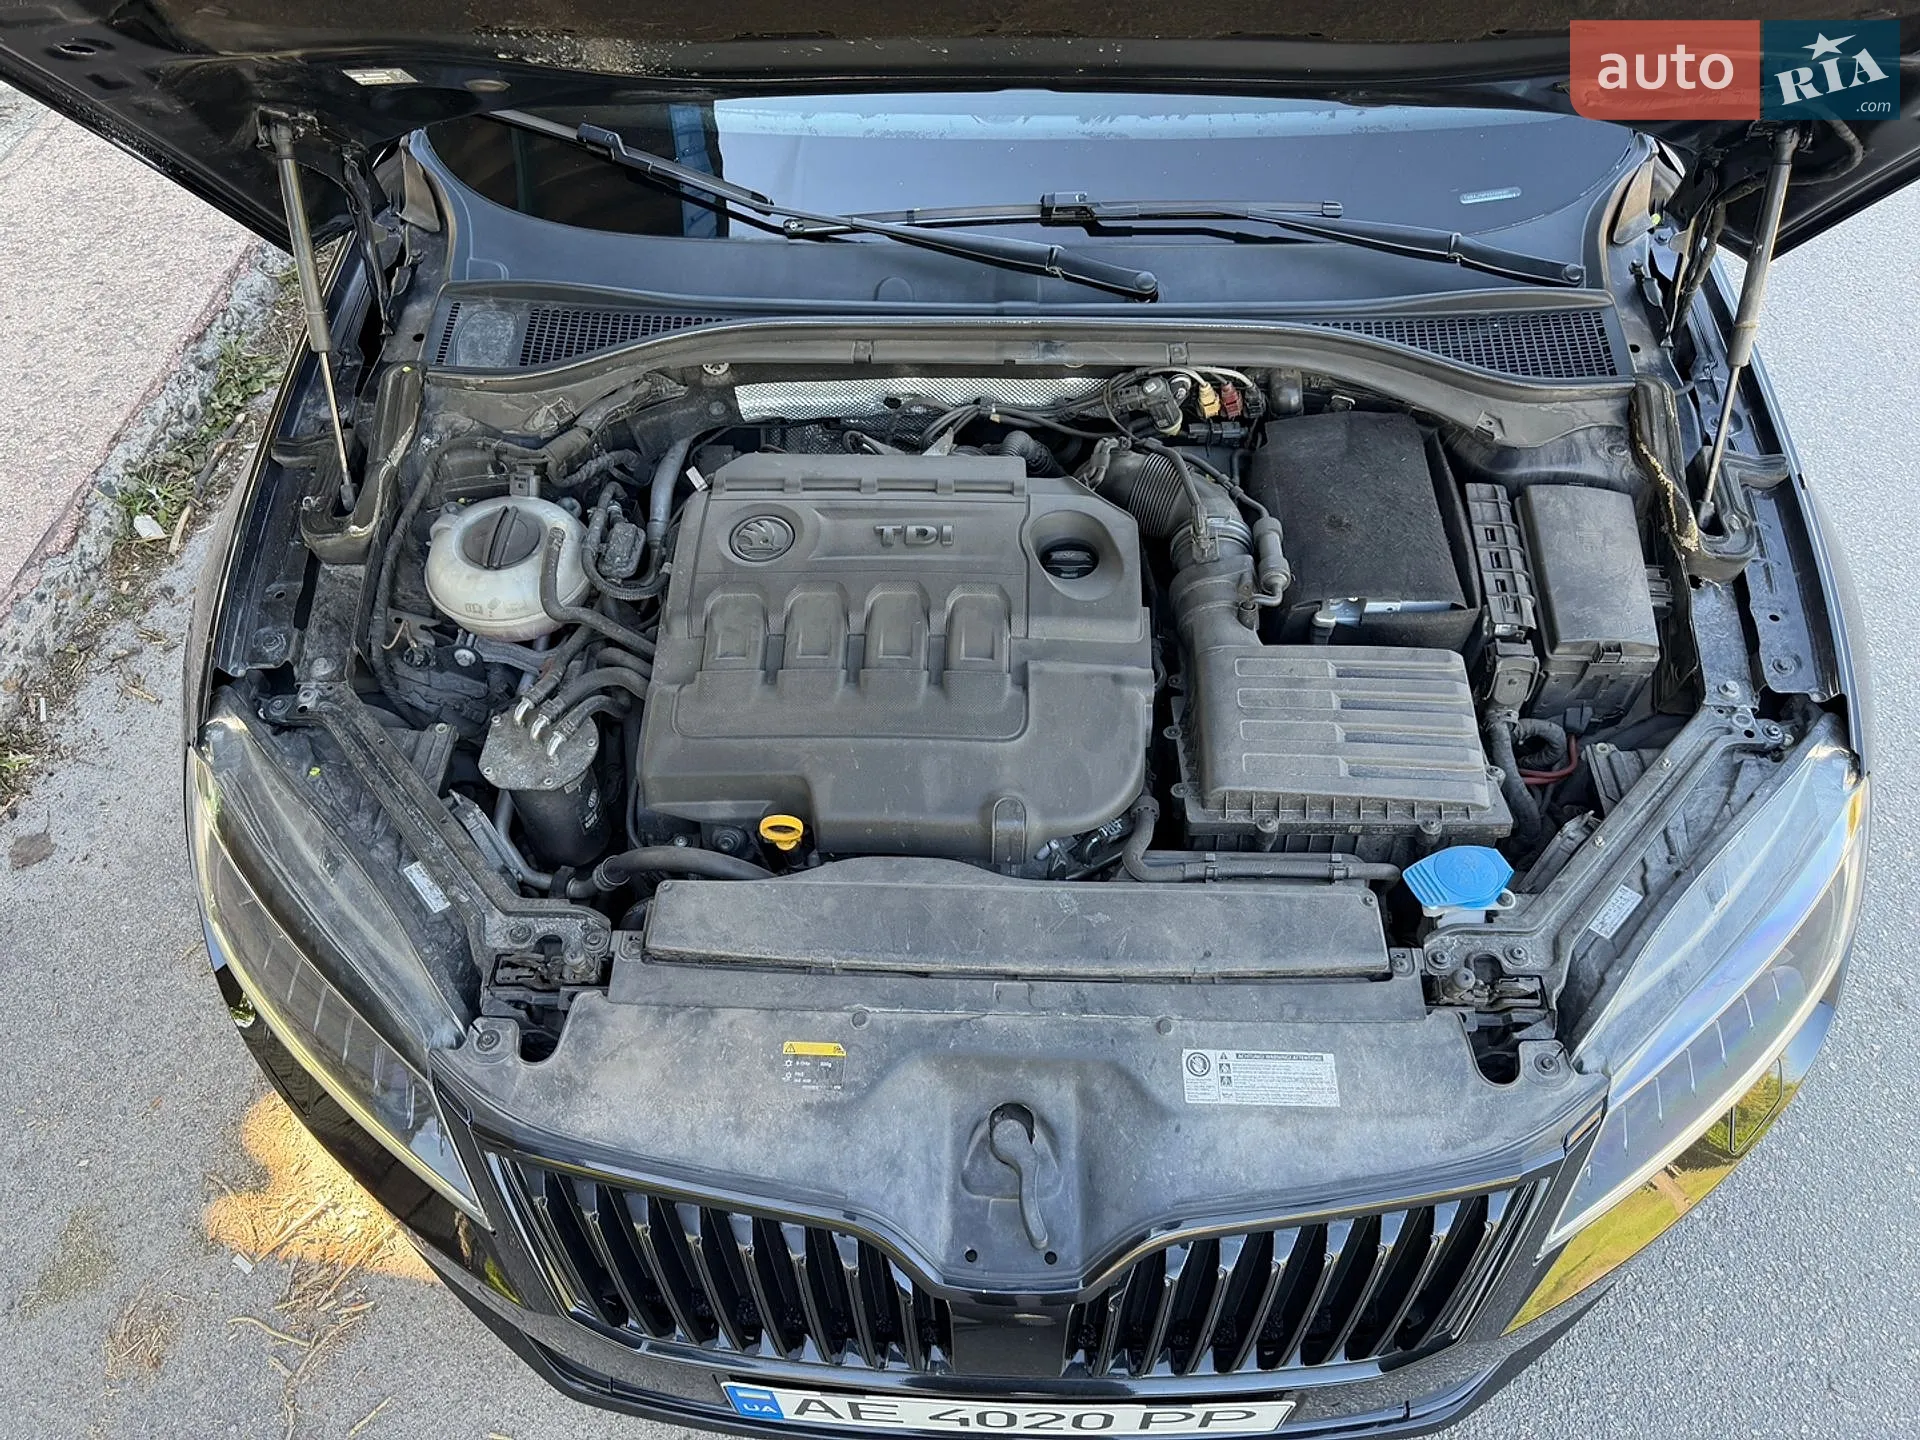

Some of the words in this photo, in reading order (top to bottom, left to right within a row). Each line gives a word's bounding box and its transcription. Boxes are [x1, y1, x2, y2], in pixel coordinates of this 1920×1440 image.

[873, 524, 955, 547] TDI
[743, 1403, 777, 1414] UA
[794, 1398, 904, 1424] AE
[928, 1408, 1114, 1431] 4020
[1138, 1409, 1256, 1430] PP
